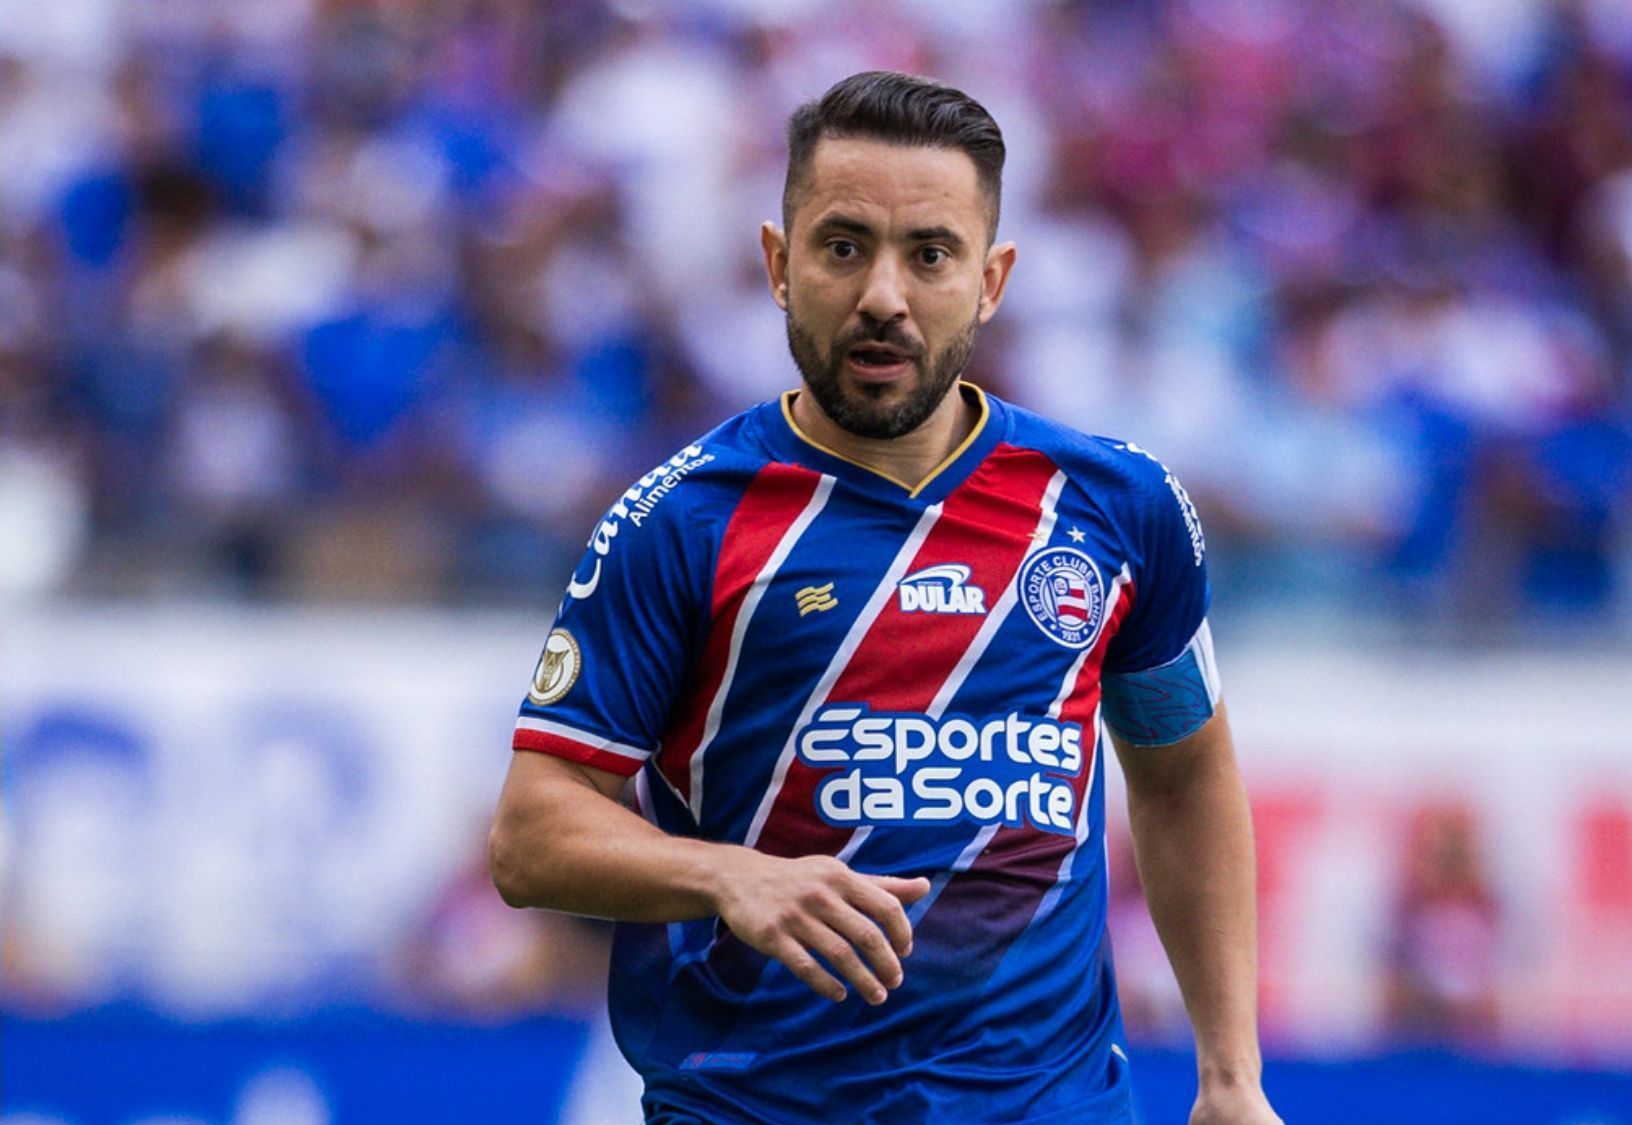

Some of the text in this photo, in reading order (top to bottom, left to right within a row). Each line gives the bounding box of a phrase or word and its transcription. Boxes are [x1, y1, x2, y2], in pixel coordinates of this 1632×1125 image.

[629, 453, 715, 528] Alimentos
[900, 584, 987, 614] DULAR
[1028, 560, 1053, 622] ESPORTE
[1052, 555, 1095, 582] CLUBE
[801, 707, 1082, 775] Esportes
